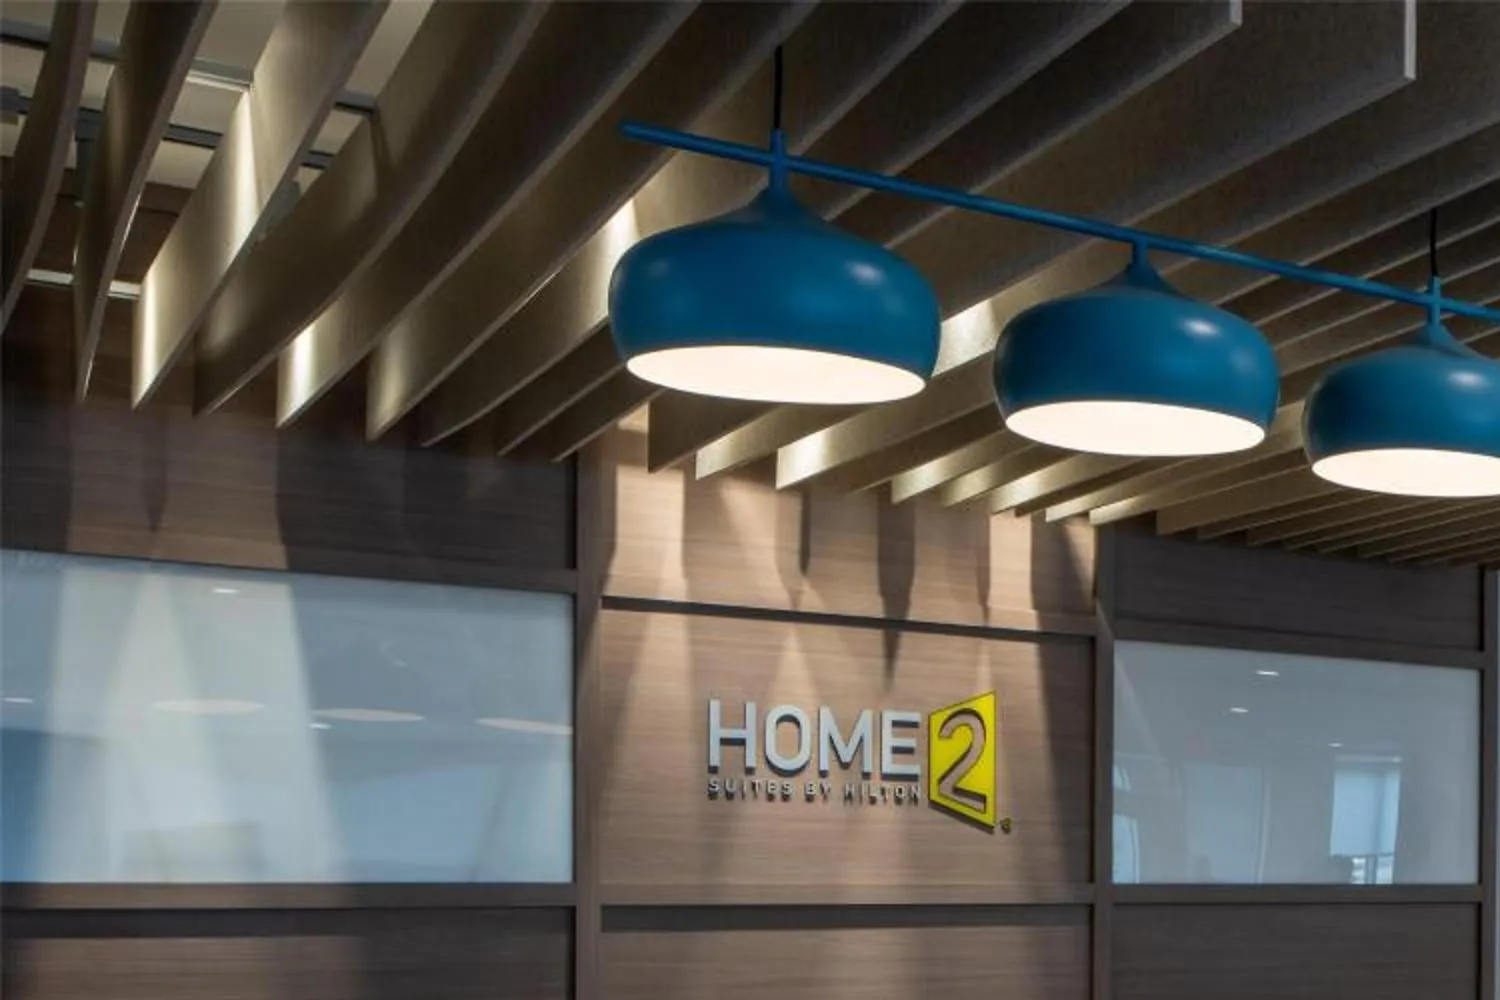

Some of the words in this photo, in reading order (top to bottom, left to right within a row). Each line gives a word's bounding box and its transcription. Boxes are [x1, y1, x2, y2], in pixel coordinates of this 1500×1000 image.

[707, 777, 794, 800] SUITES
[805, 780, 832, 800] BY
[843, 783, 921, 803] HILTON
